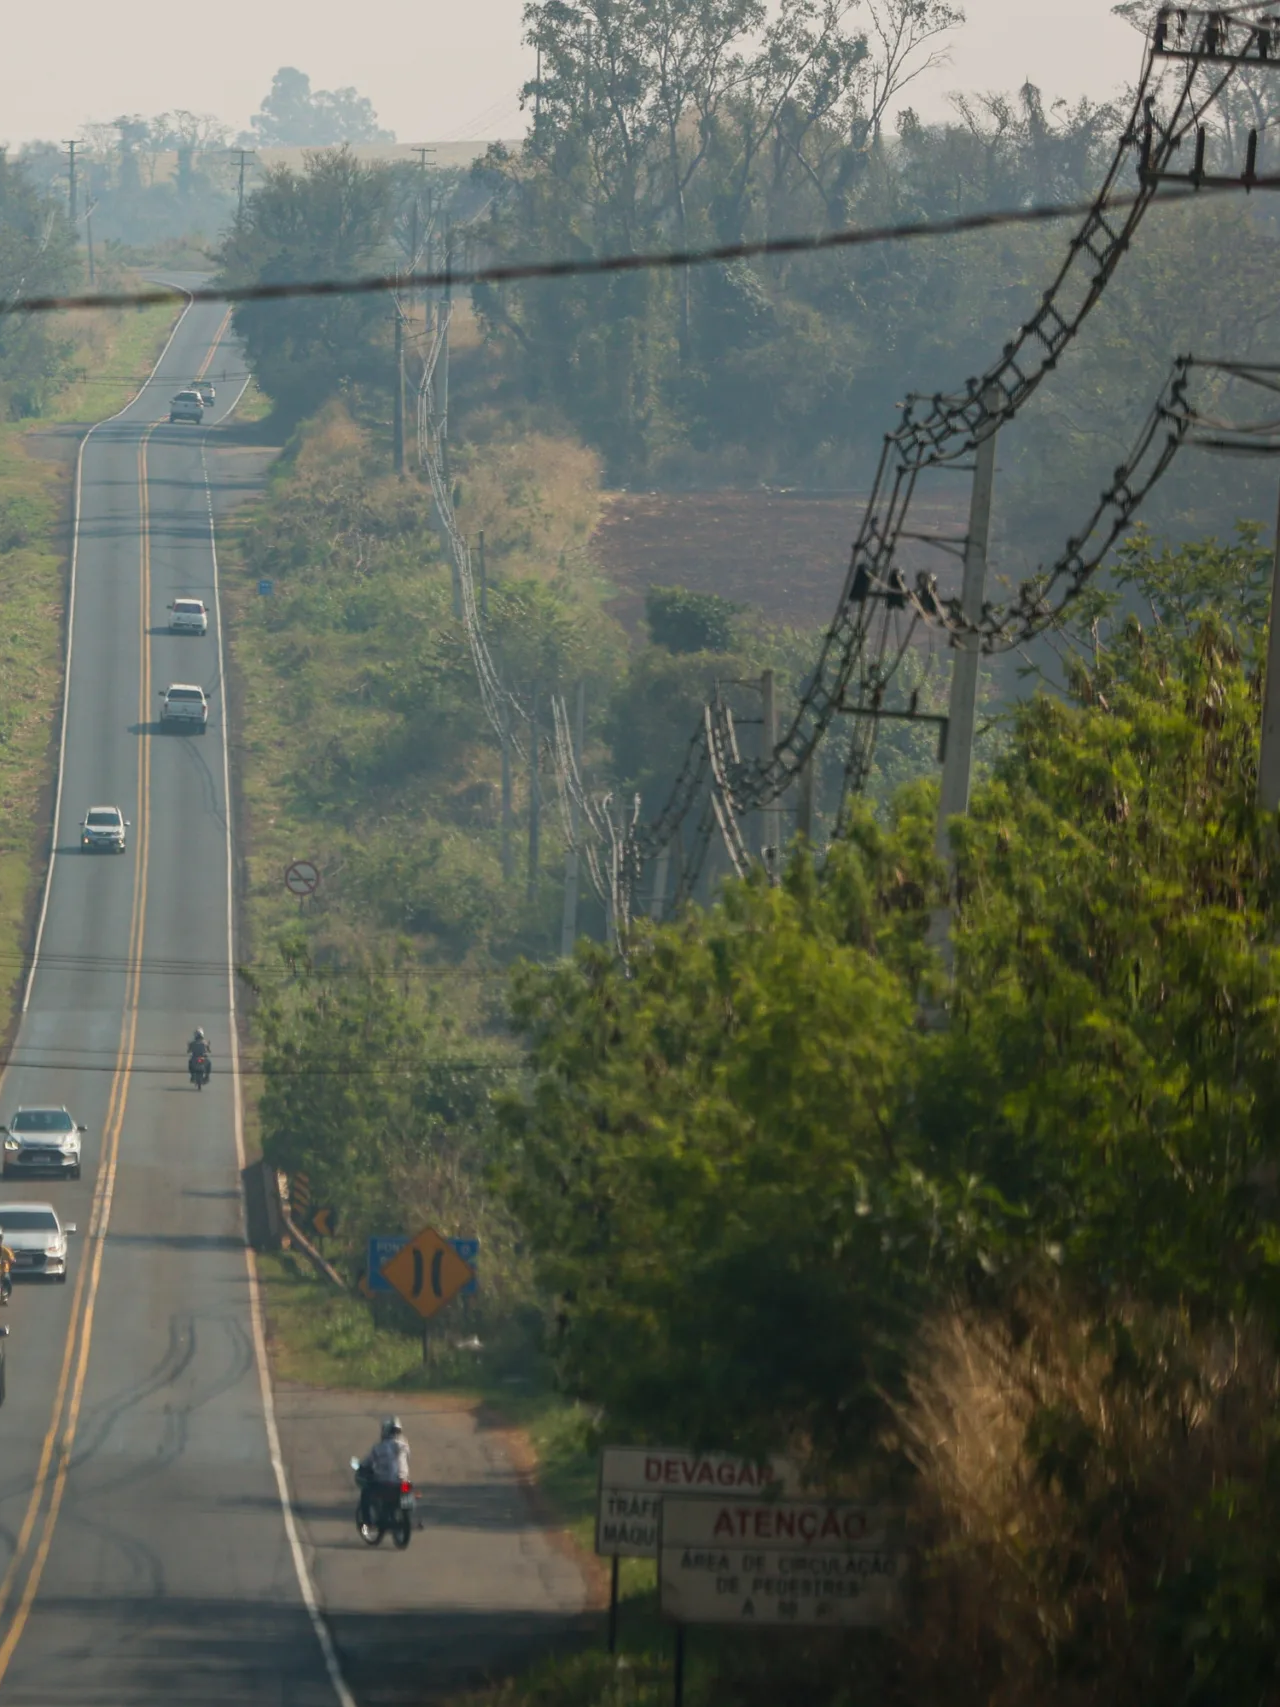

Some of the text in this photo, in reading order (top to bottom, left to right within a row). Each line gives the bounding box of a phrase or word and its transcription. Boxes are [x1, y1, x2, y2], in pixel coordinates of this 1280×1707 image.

[377, 1240, 402, 1253] PON
[645, 1458, 776, 1485] DEVAGAR
[714, 1508, 867, 1545] ATENÇÃO
[743, 1556, 766, 1573] DE
[716, 1576, 739, 1594] DE
